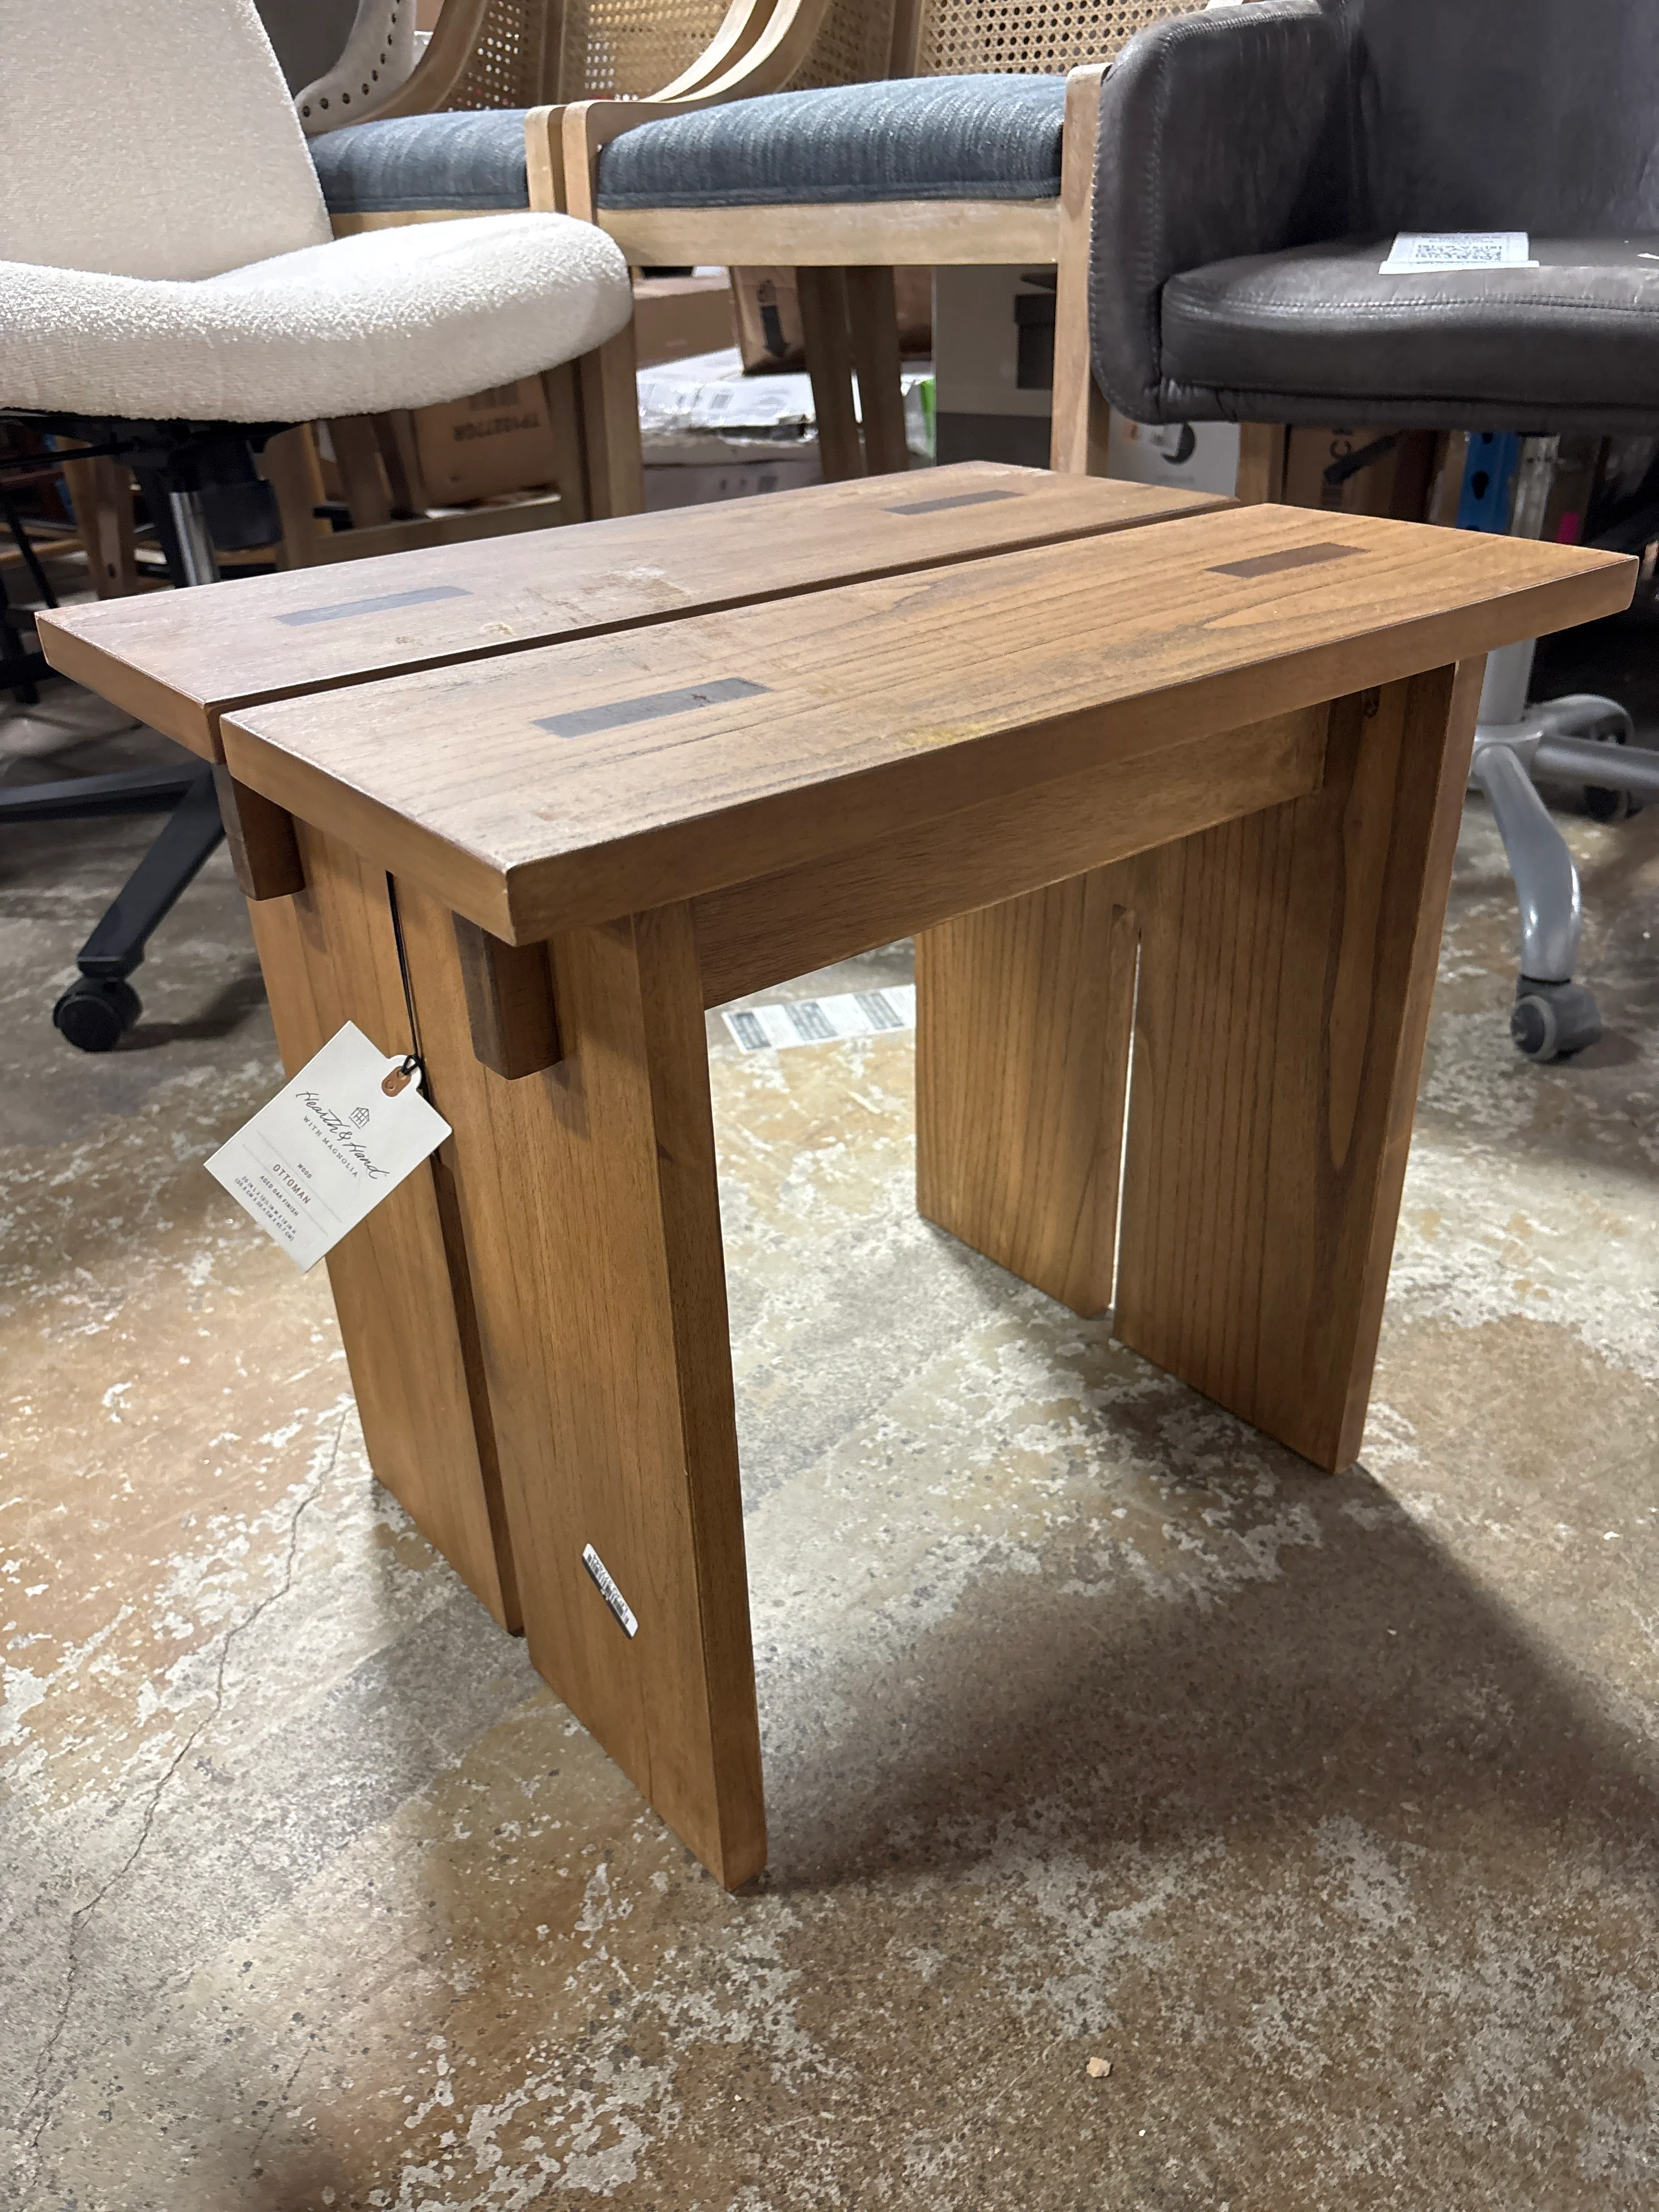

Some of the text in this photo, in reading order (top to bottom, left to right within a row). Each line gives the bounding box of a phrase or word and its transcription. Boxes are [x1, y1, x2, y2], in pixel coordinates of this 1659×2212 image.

[295, 1091, 390, 1180] Hearth & Hand
[303, 1115, 358, 1177] WITH MAGNOLIA
[273, 1164, 311, 1204] OTTOMAN
[297, 1163, 312, 1179] WOOD
[259, 1175, 299, 1217] AGED OAK FINISH
[276, 1222, 286, 1232] 47
